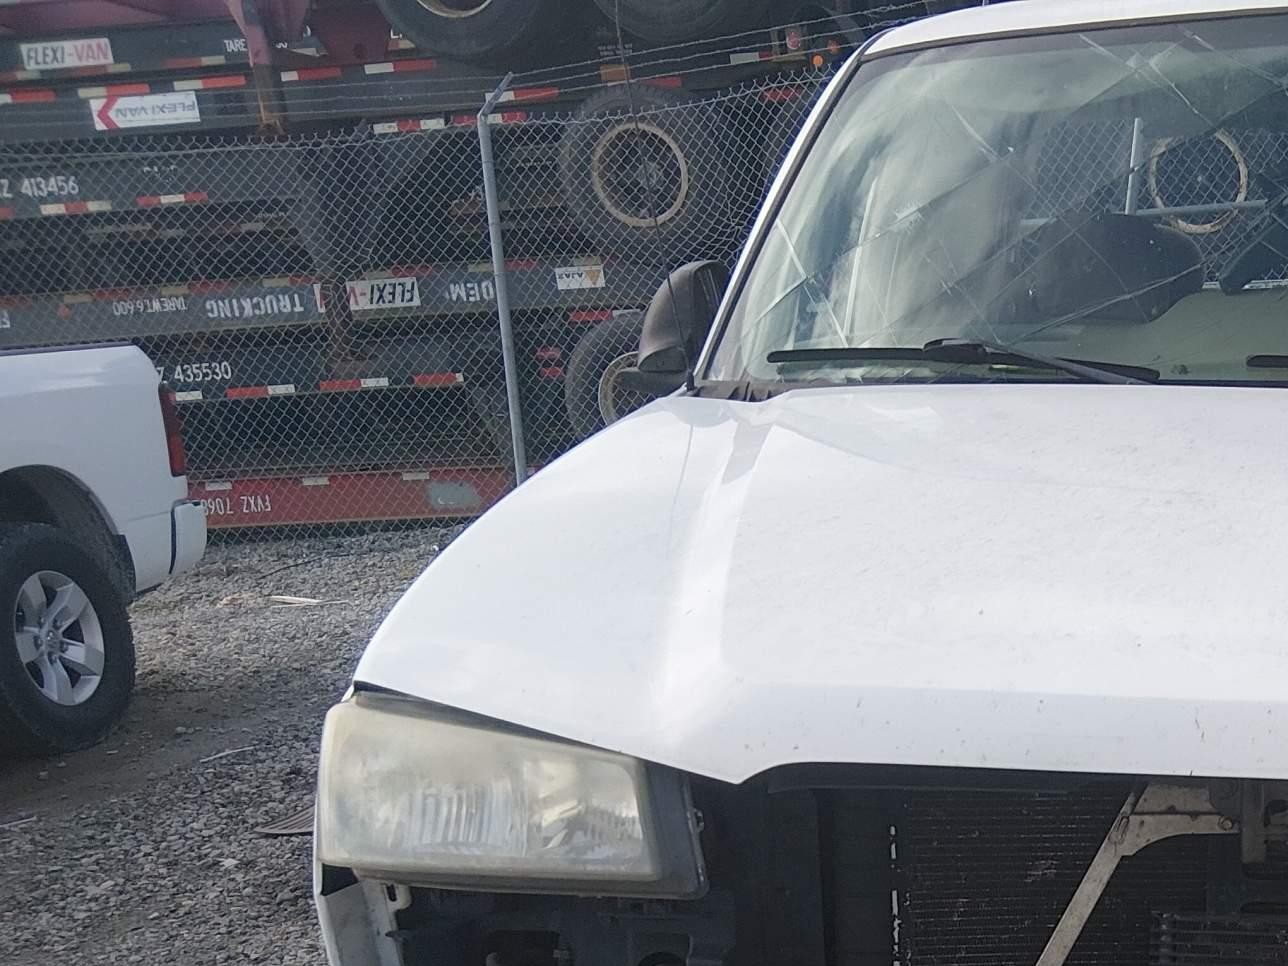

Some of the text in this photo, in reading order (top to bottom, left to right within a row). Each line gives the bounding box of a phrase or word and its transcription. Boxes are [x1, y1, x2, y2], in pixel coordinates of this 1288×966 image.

[224, 38, 247, 52] TARE
[20, 175, 80, 197] 413456
[345, 281, 415, 306] FLEXI-V
[205, 293, 304, 318] TRUCKING
[174, 361, 232, 383] 435530
[240, 494, 271, 513] FVXZ
